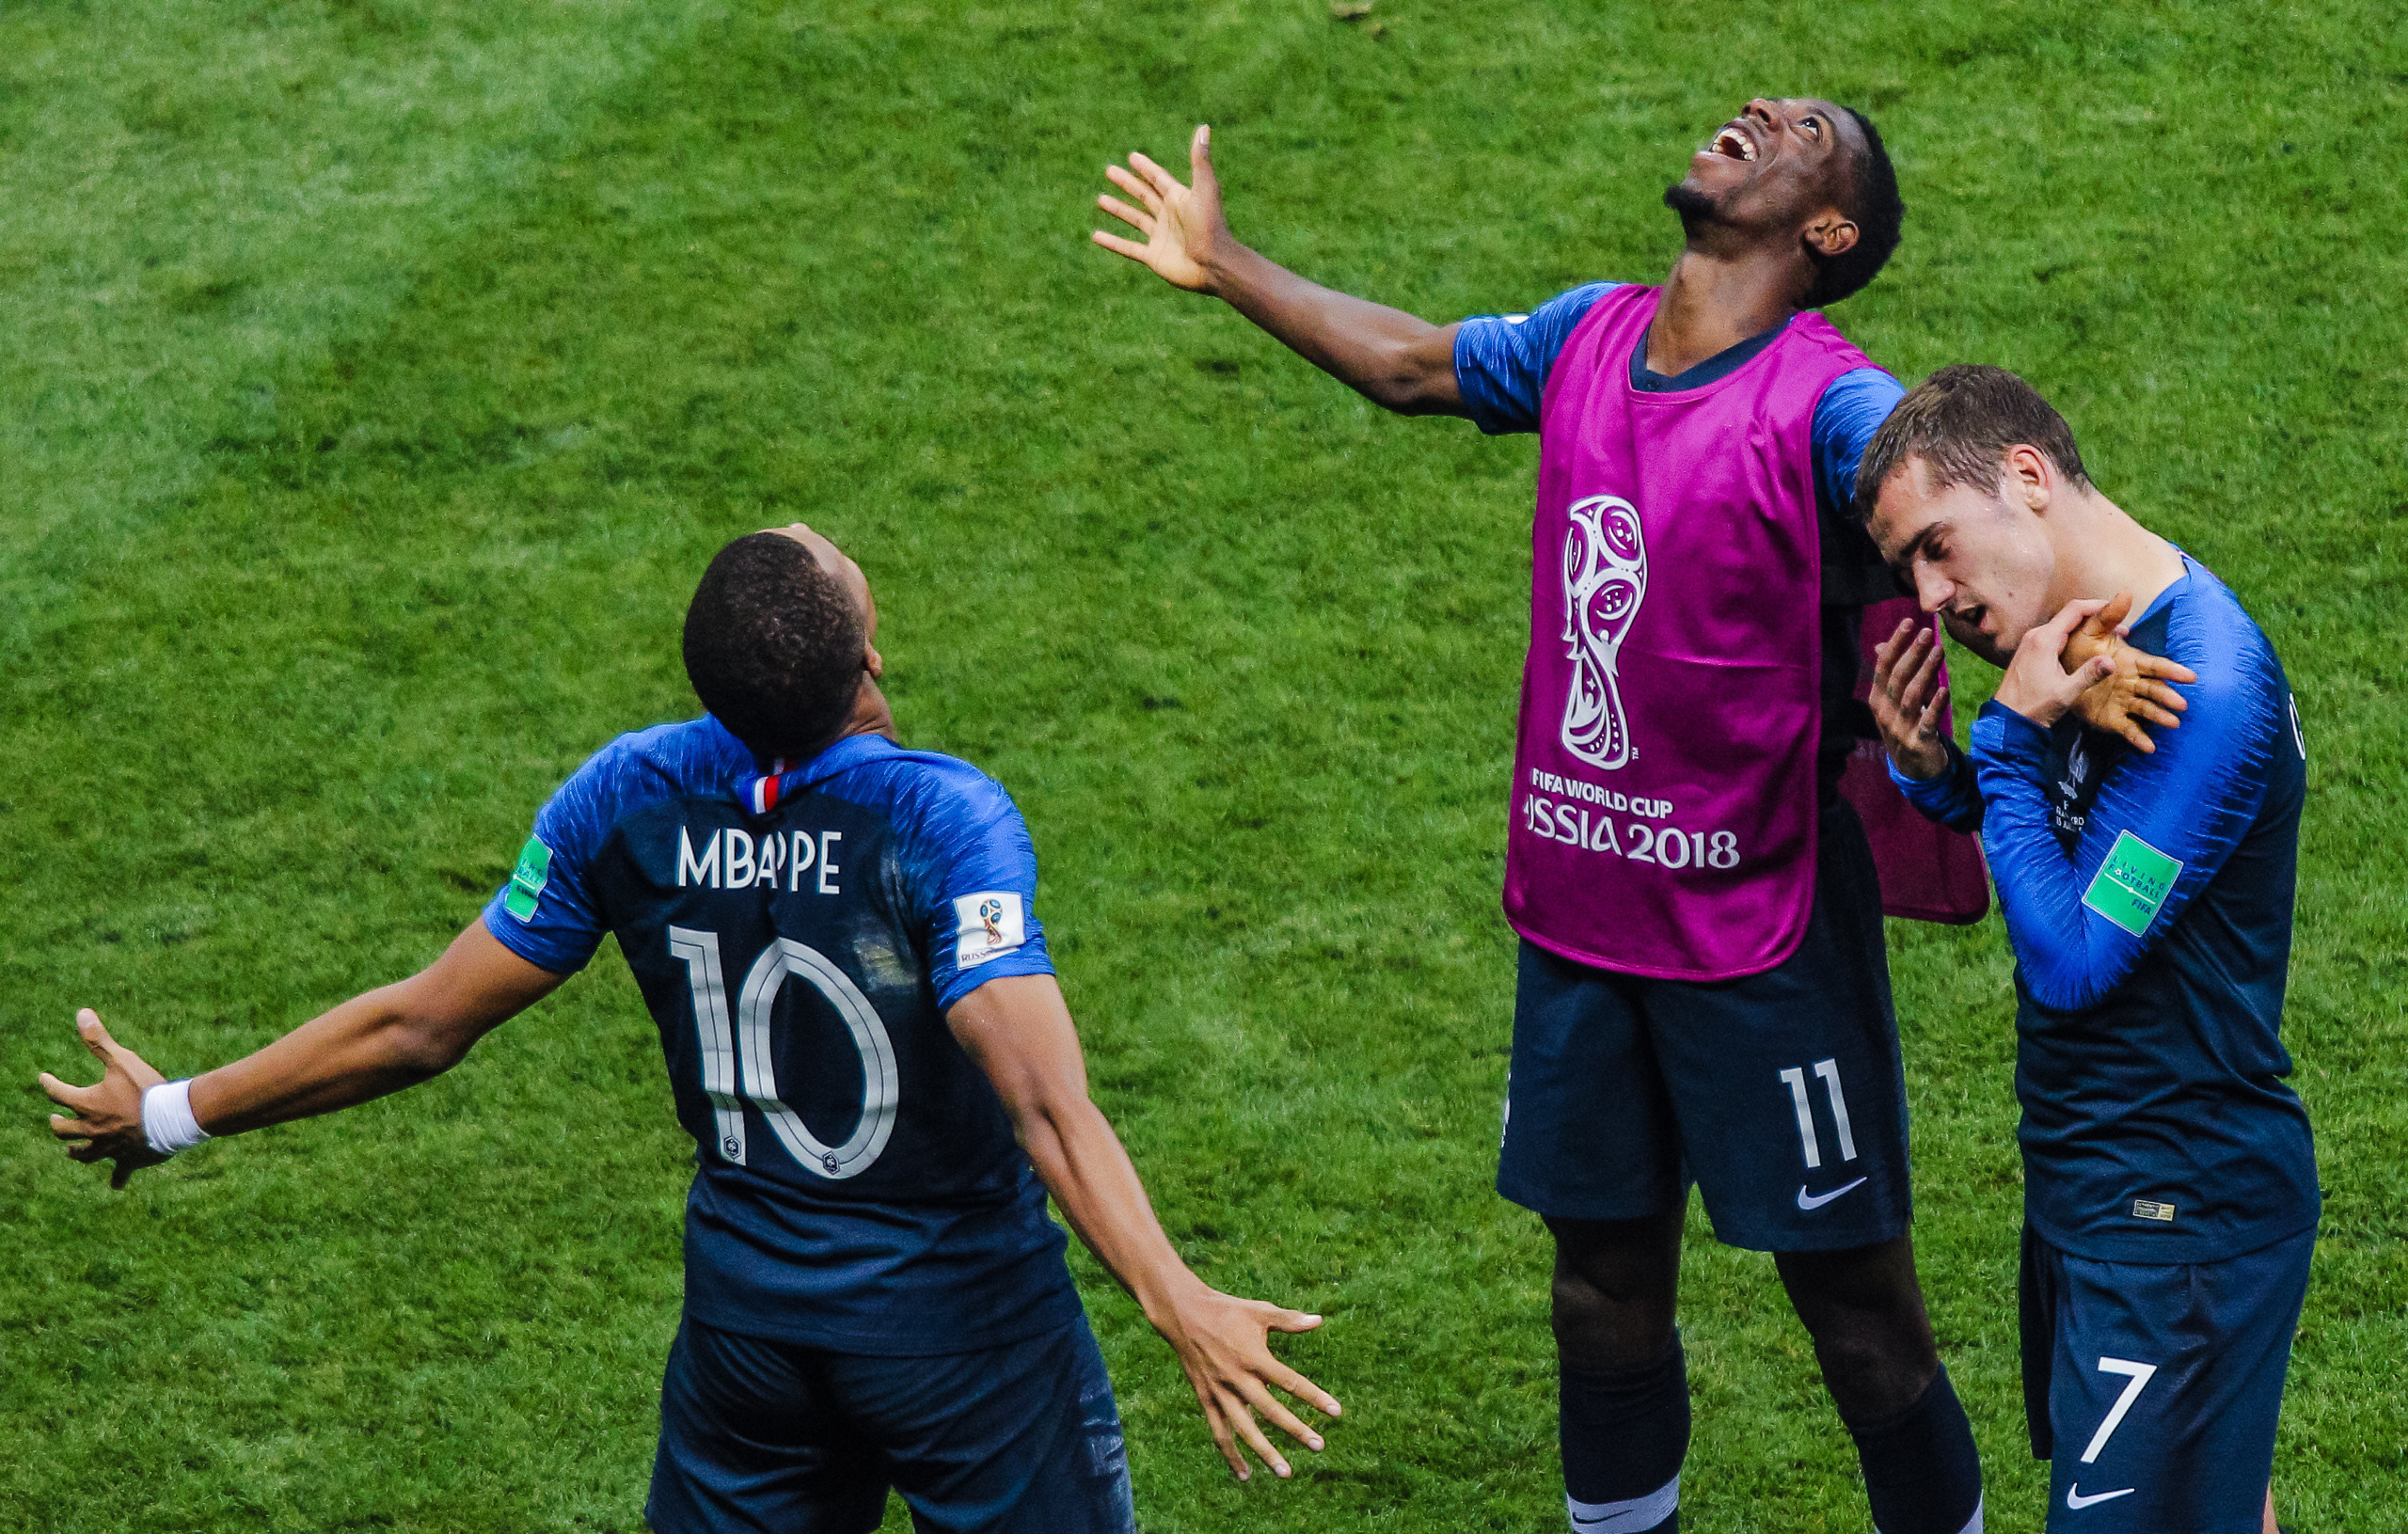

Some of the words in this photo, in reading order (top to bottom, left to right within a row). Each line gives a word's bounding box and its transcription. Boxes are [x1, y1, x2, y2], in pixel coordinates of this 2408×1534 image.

[1532, 767, 1564, 795] FIFA
[1564, 779, 1628, 812] WORLD
[1630, 798, 1674, 819] CUP
[1524, 794, 1623, 856] SSIA
[1626, 824, 1741, 869] 2018
[2108, 863, 2160, 898] FOOTBALL
[2113, 856, 2165, 891] LIVING
[2131, 898, 2152, 915] FIFA
[669, 925, 899, 1180] 10
[1780, 1058, 1858, 1168] 11
[2080, 1356, 2158, 1463] 7
